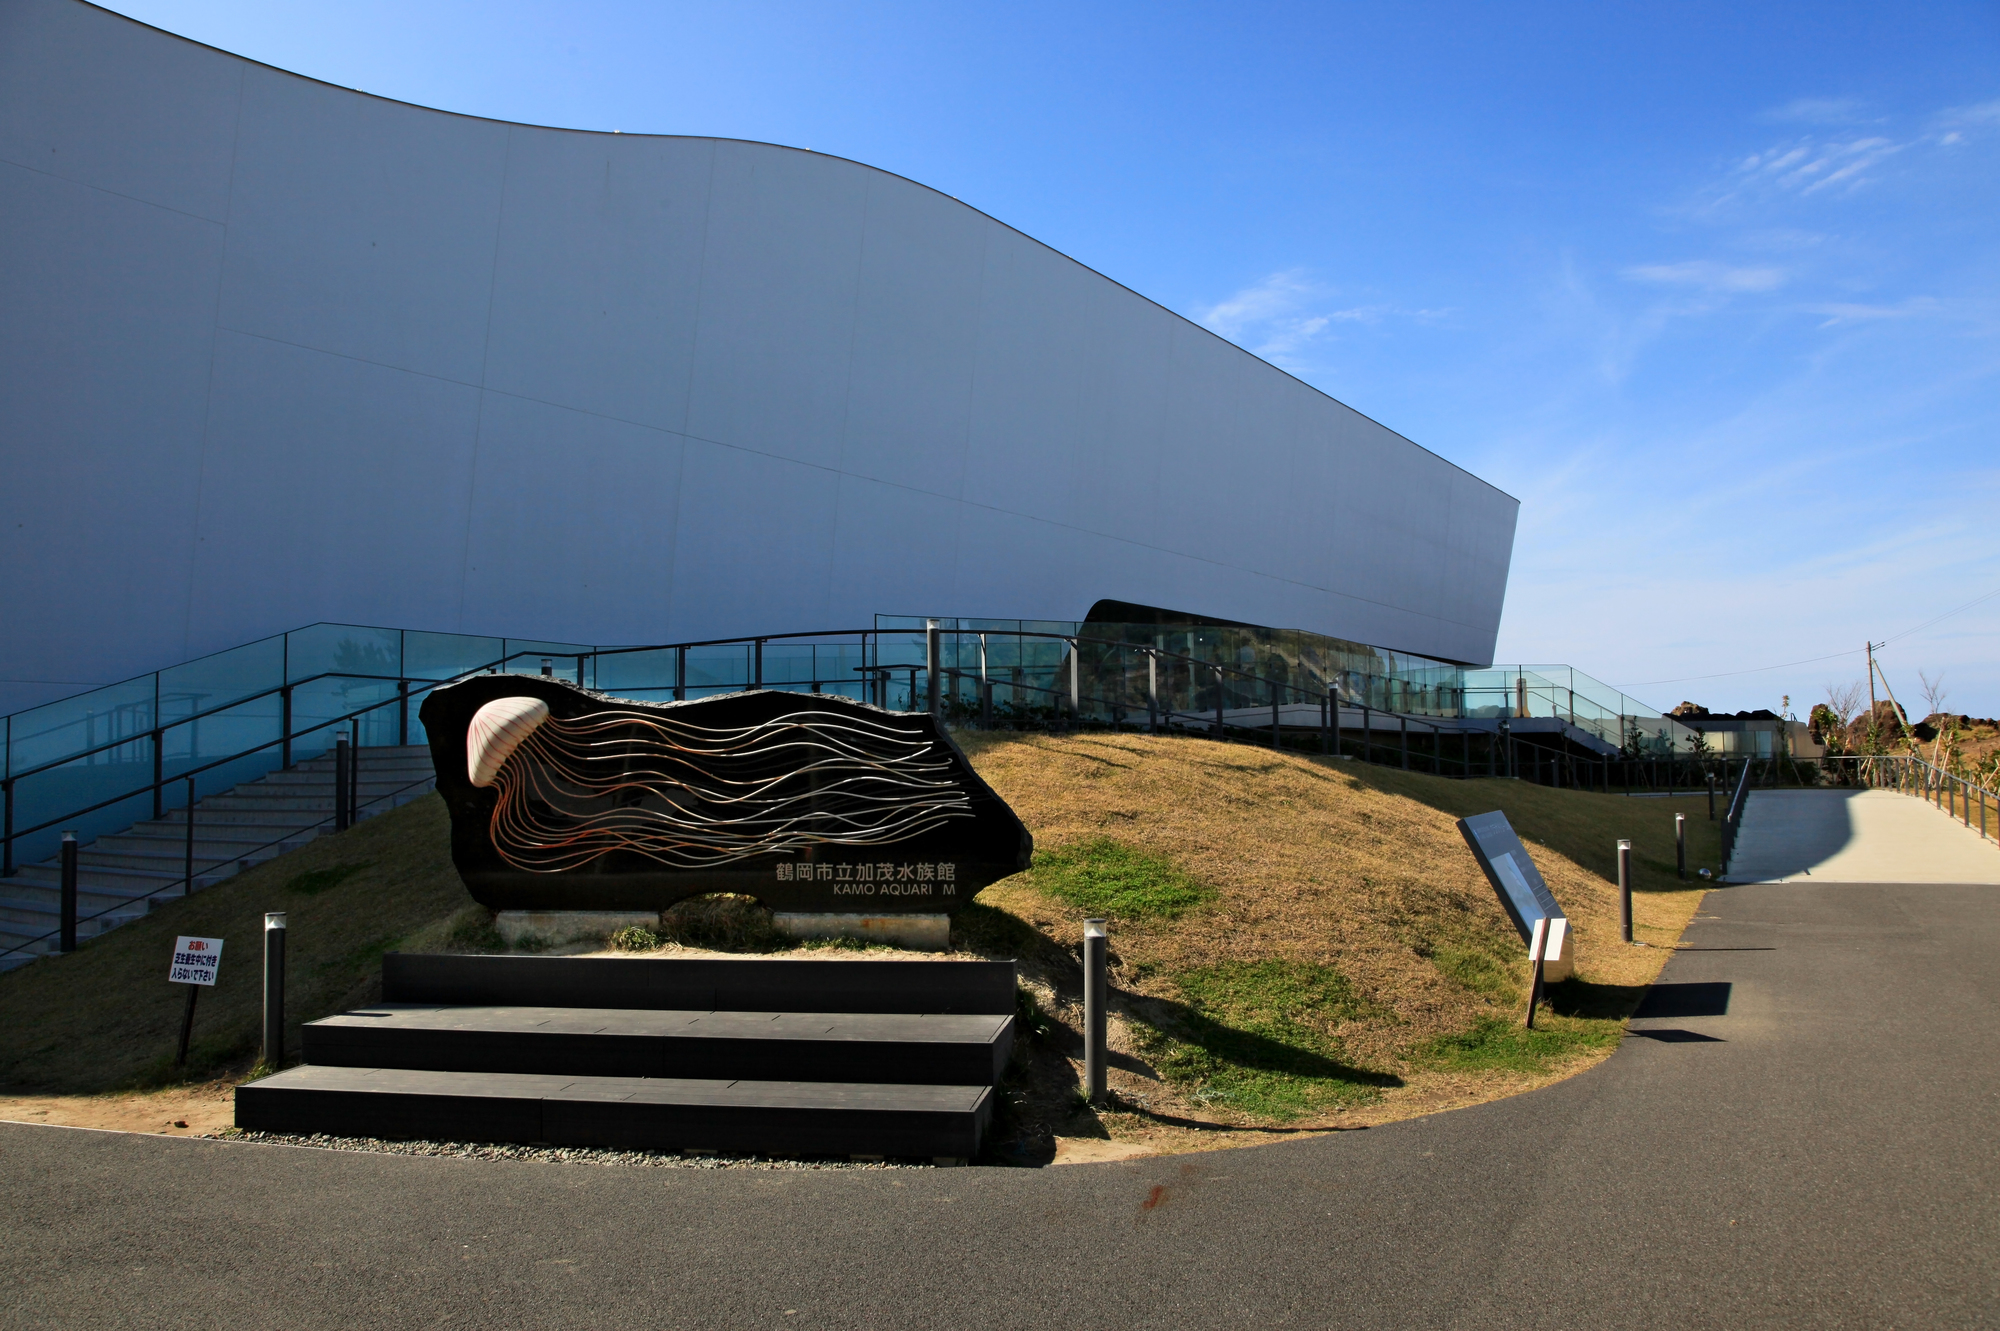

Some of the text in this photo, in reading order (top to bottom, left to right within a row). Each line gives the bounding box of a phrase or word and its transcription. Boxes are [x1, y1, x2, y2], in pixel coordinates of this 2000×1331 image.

[776, 862, 955, 881] 鶴岡市立加茂水族館
[834, 884, 955, 896] KAMO AQUARIM
[188, 941, 208, 951] お願い
[171, 968, 214, 981] 入らないで下さい
